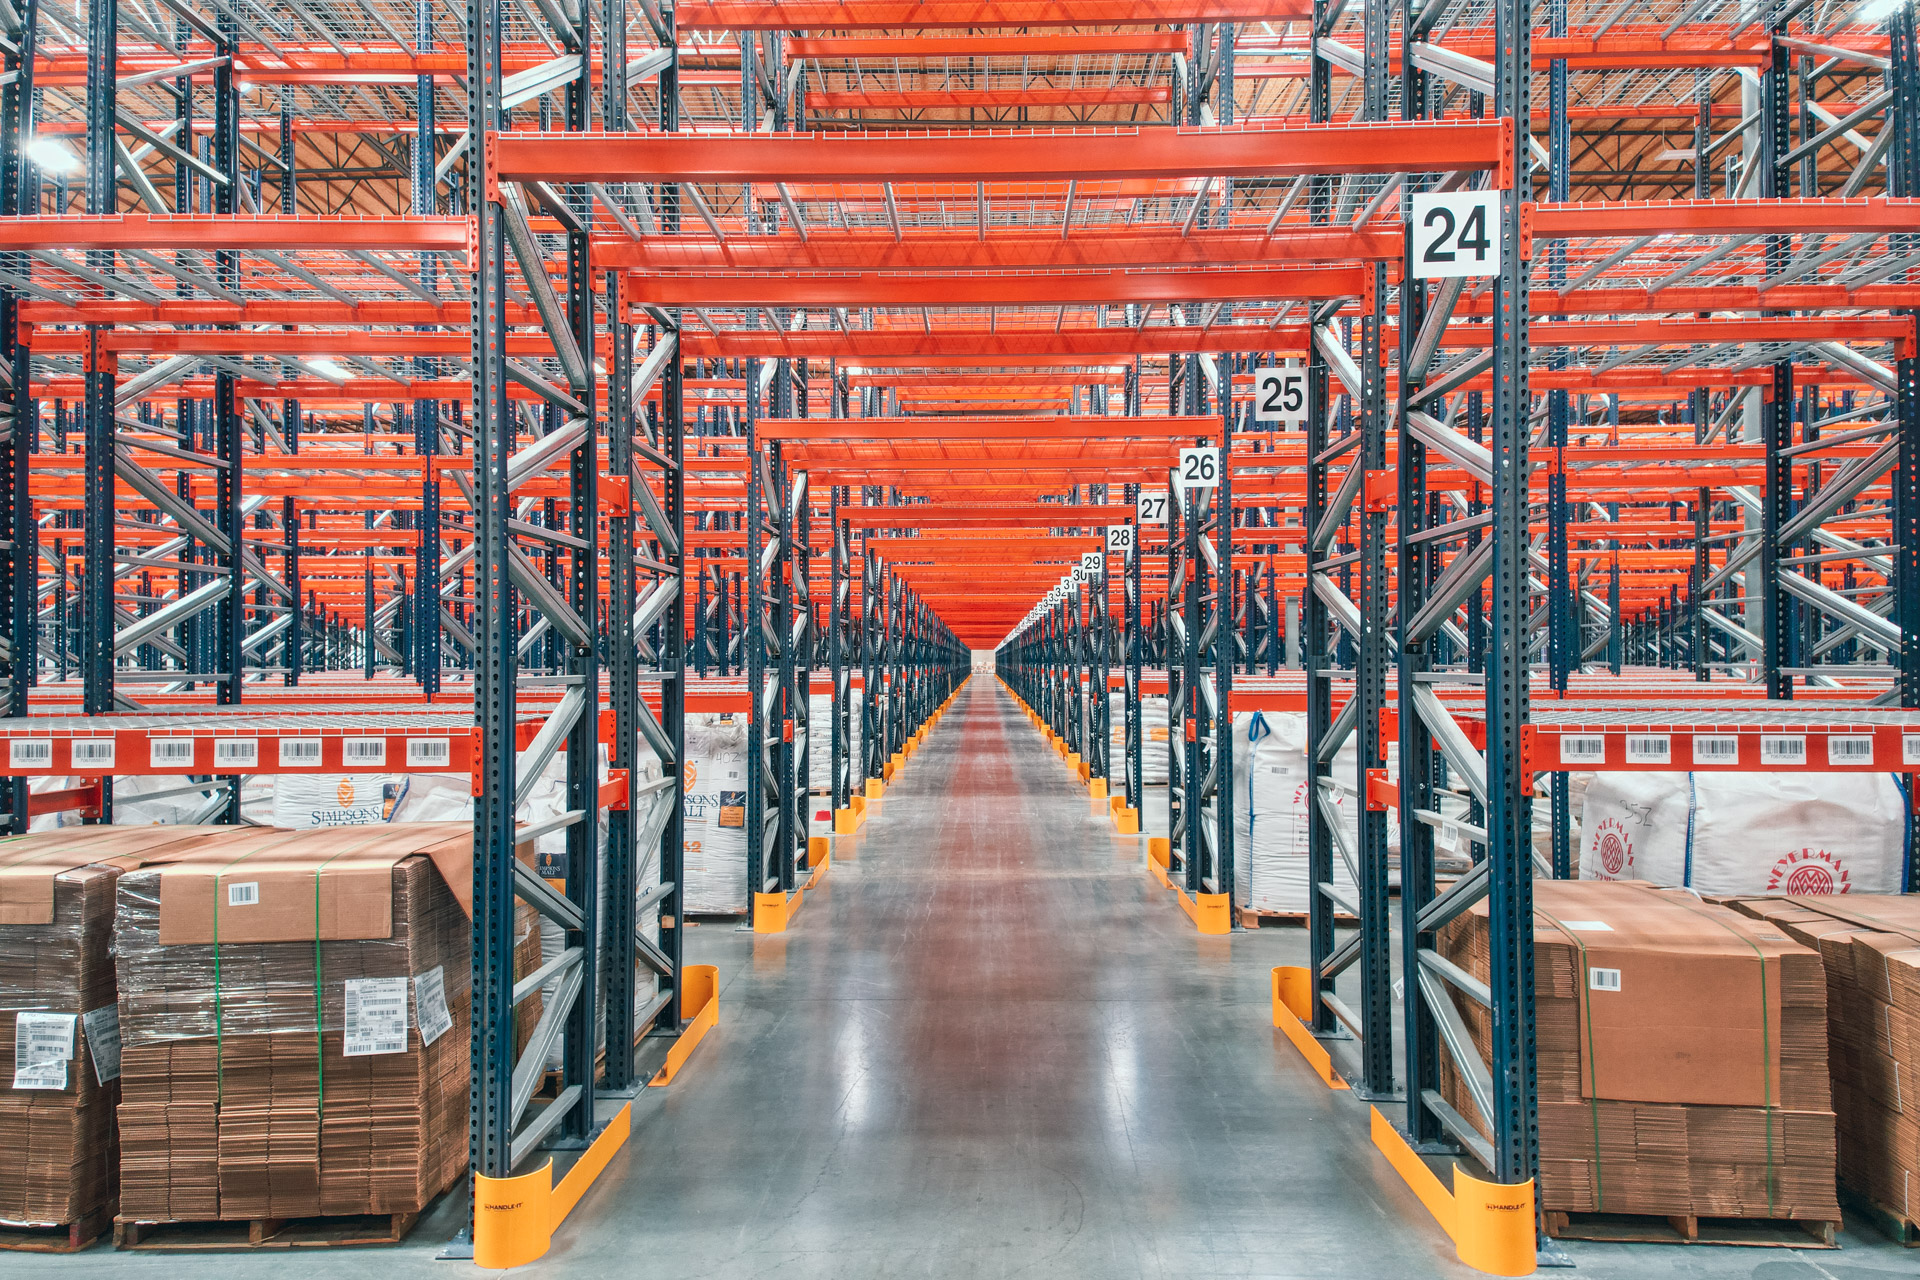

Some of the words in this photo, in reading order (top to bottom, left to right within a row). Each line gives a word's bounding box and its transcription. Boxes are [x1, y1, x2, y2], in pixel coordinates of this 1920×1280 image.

[1423, 205, 1491, 262] 24
[1262, 376, 1303, 413] 25
[1184, 454, 1215, 480] 26
[1141, 498, 1166, 519] 27
[1110, 529, 1130, 547] 28
[1084, 556, 1101, 570] 29
[1063, 579, 1075, 590] 31
[1073, 569, 1087, 581] 30
[311, 806, 380, 825] SIMPSONS
[1766, 848, 1851, 895] WEYERMANN
